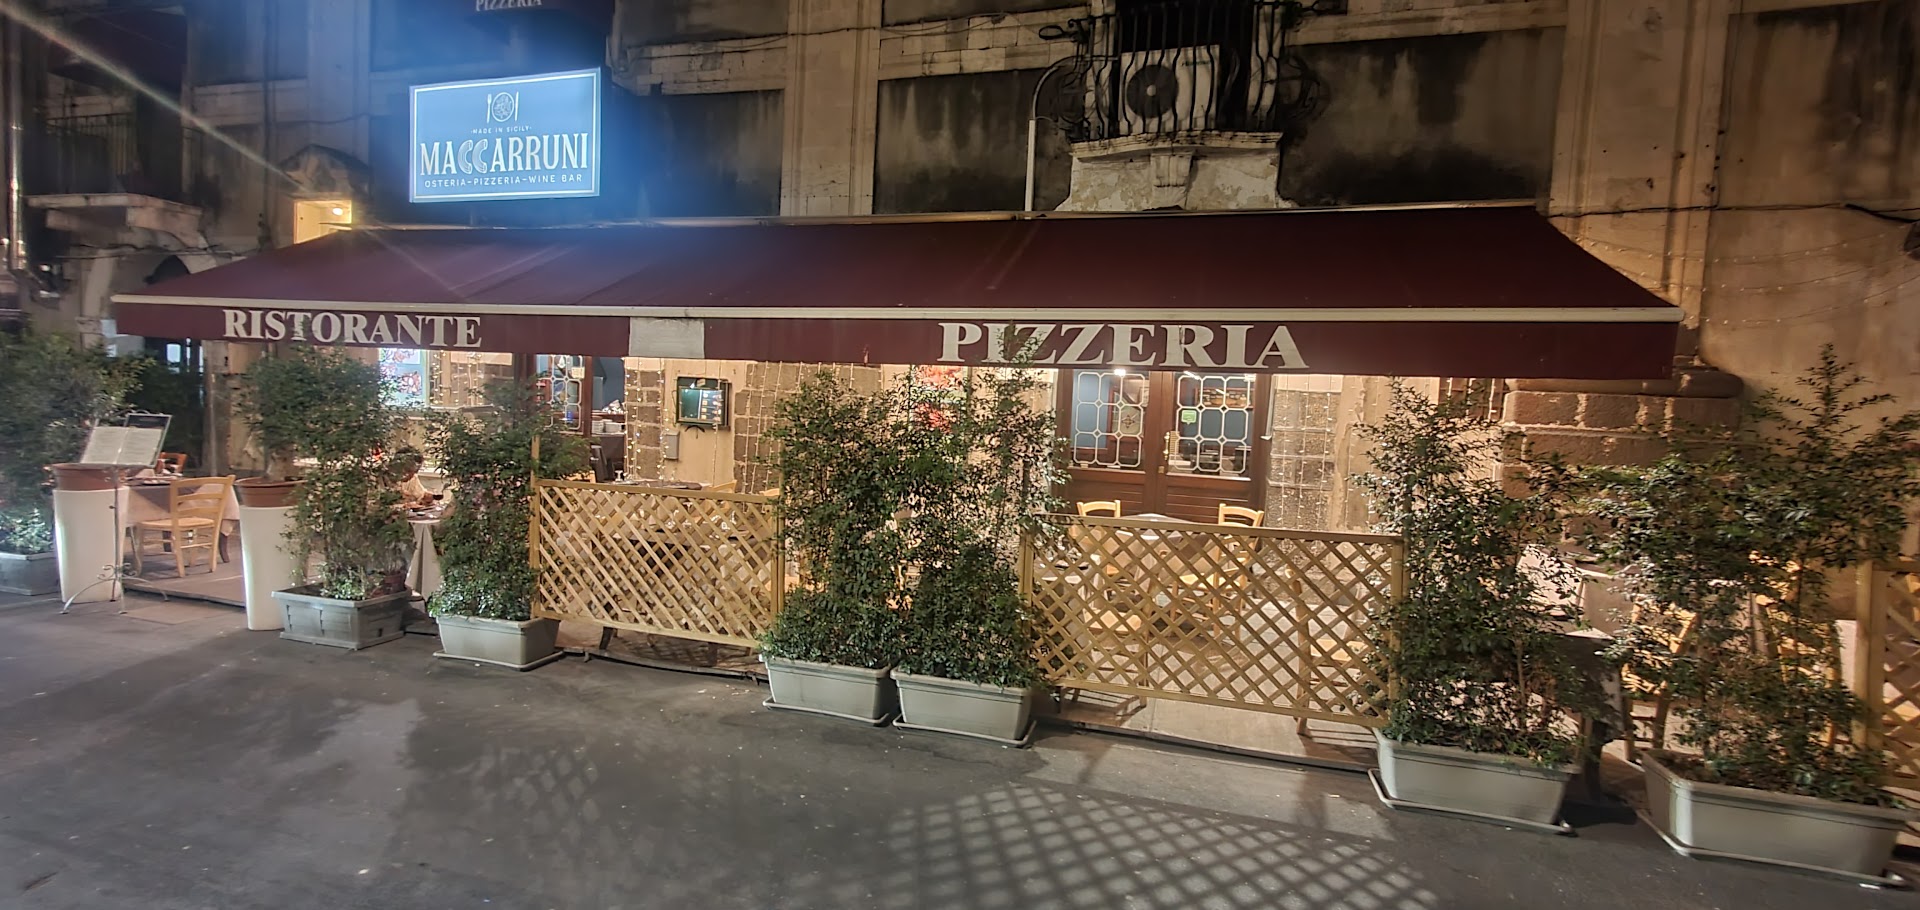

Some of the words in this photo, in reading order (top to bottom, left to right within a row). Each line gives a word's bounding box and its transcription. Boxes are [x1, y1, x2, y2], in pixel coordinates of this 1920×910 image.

[420, 132, 589, 176] MACCARRUNI
[561, 173, 582, 183] BAR
[223, 309, 482, 348] RISTORANTE
[937, 322, 1310, 369] PIZZERIA
